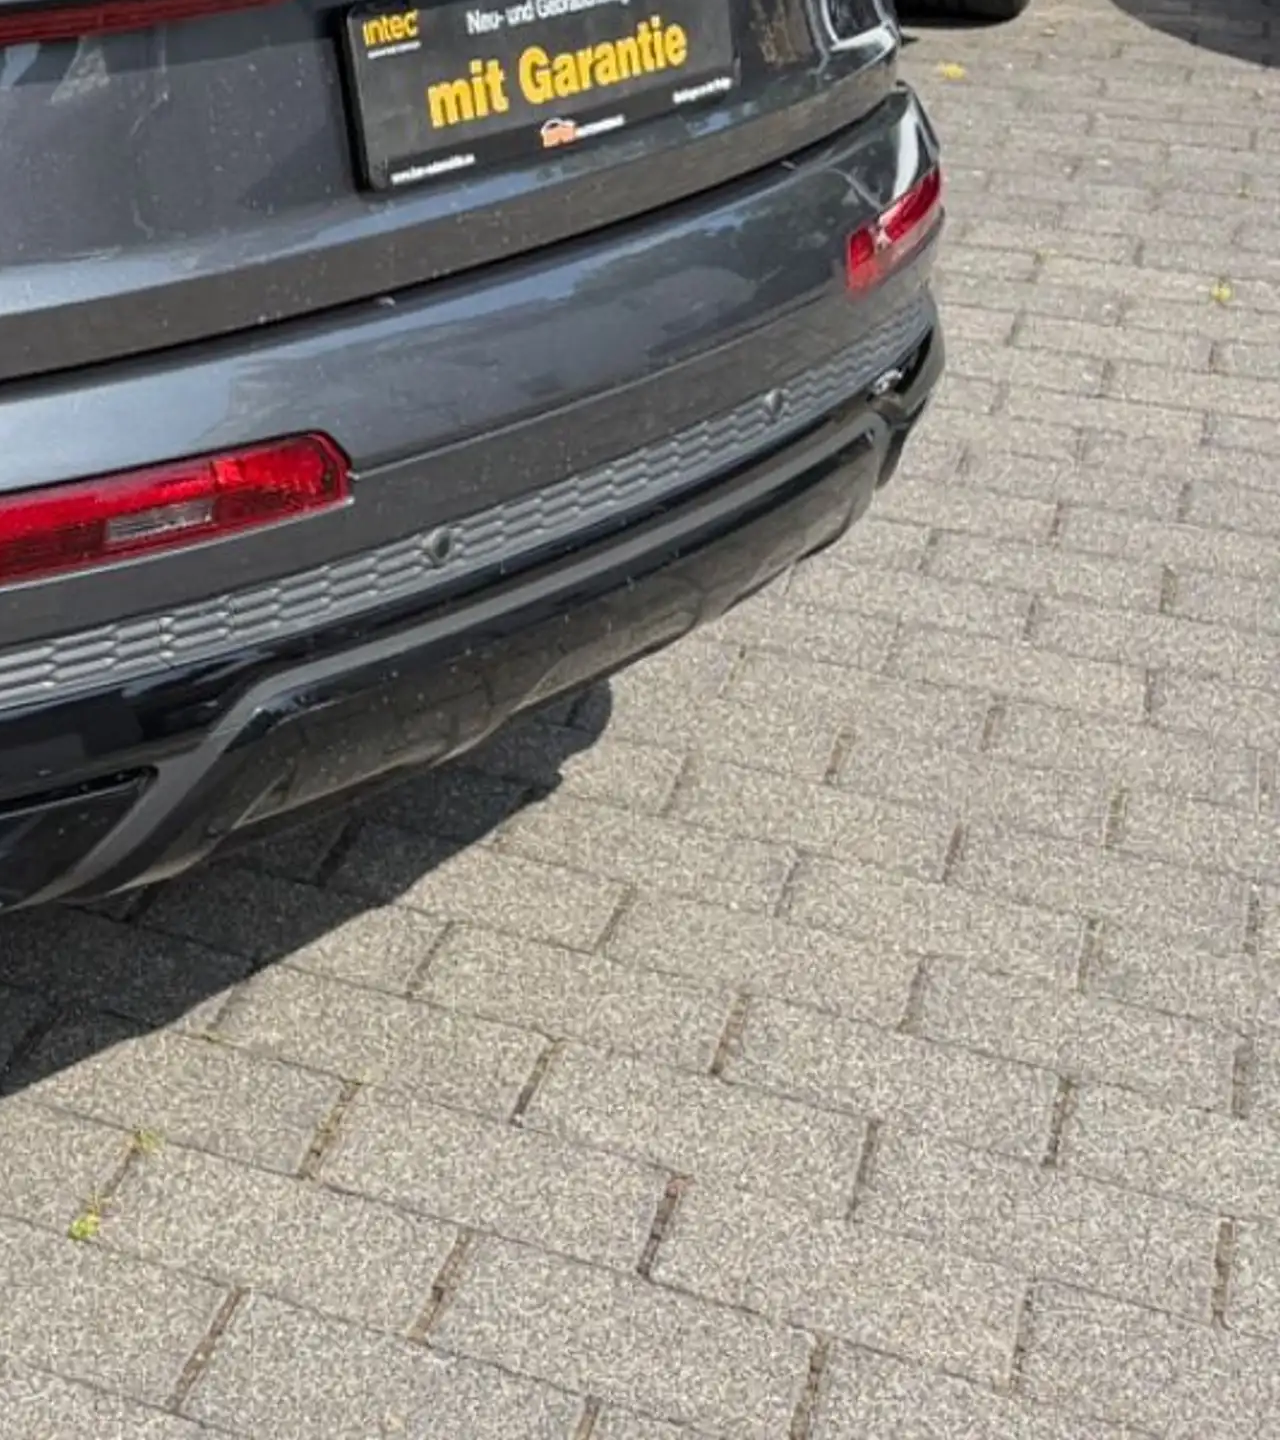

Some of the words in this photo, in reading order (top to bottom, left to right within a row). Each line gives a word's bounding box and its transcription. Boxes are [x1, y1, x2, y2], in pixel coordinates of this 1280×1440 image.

[465, 9, 504, 35] Neu-
[426, 58, 509, 128] mit
[518, 15, 688, 105] Garantie
